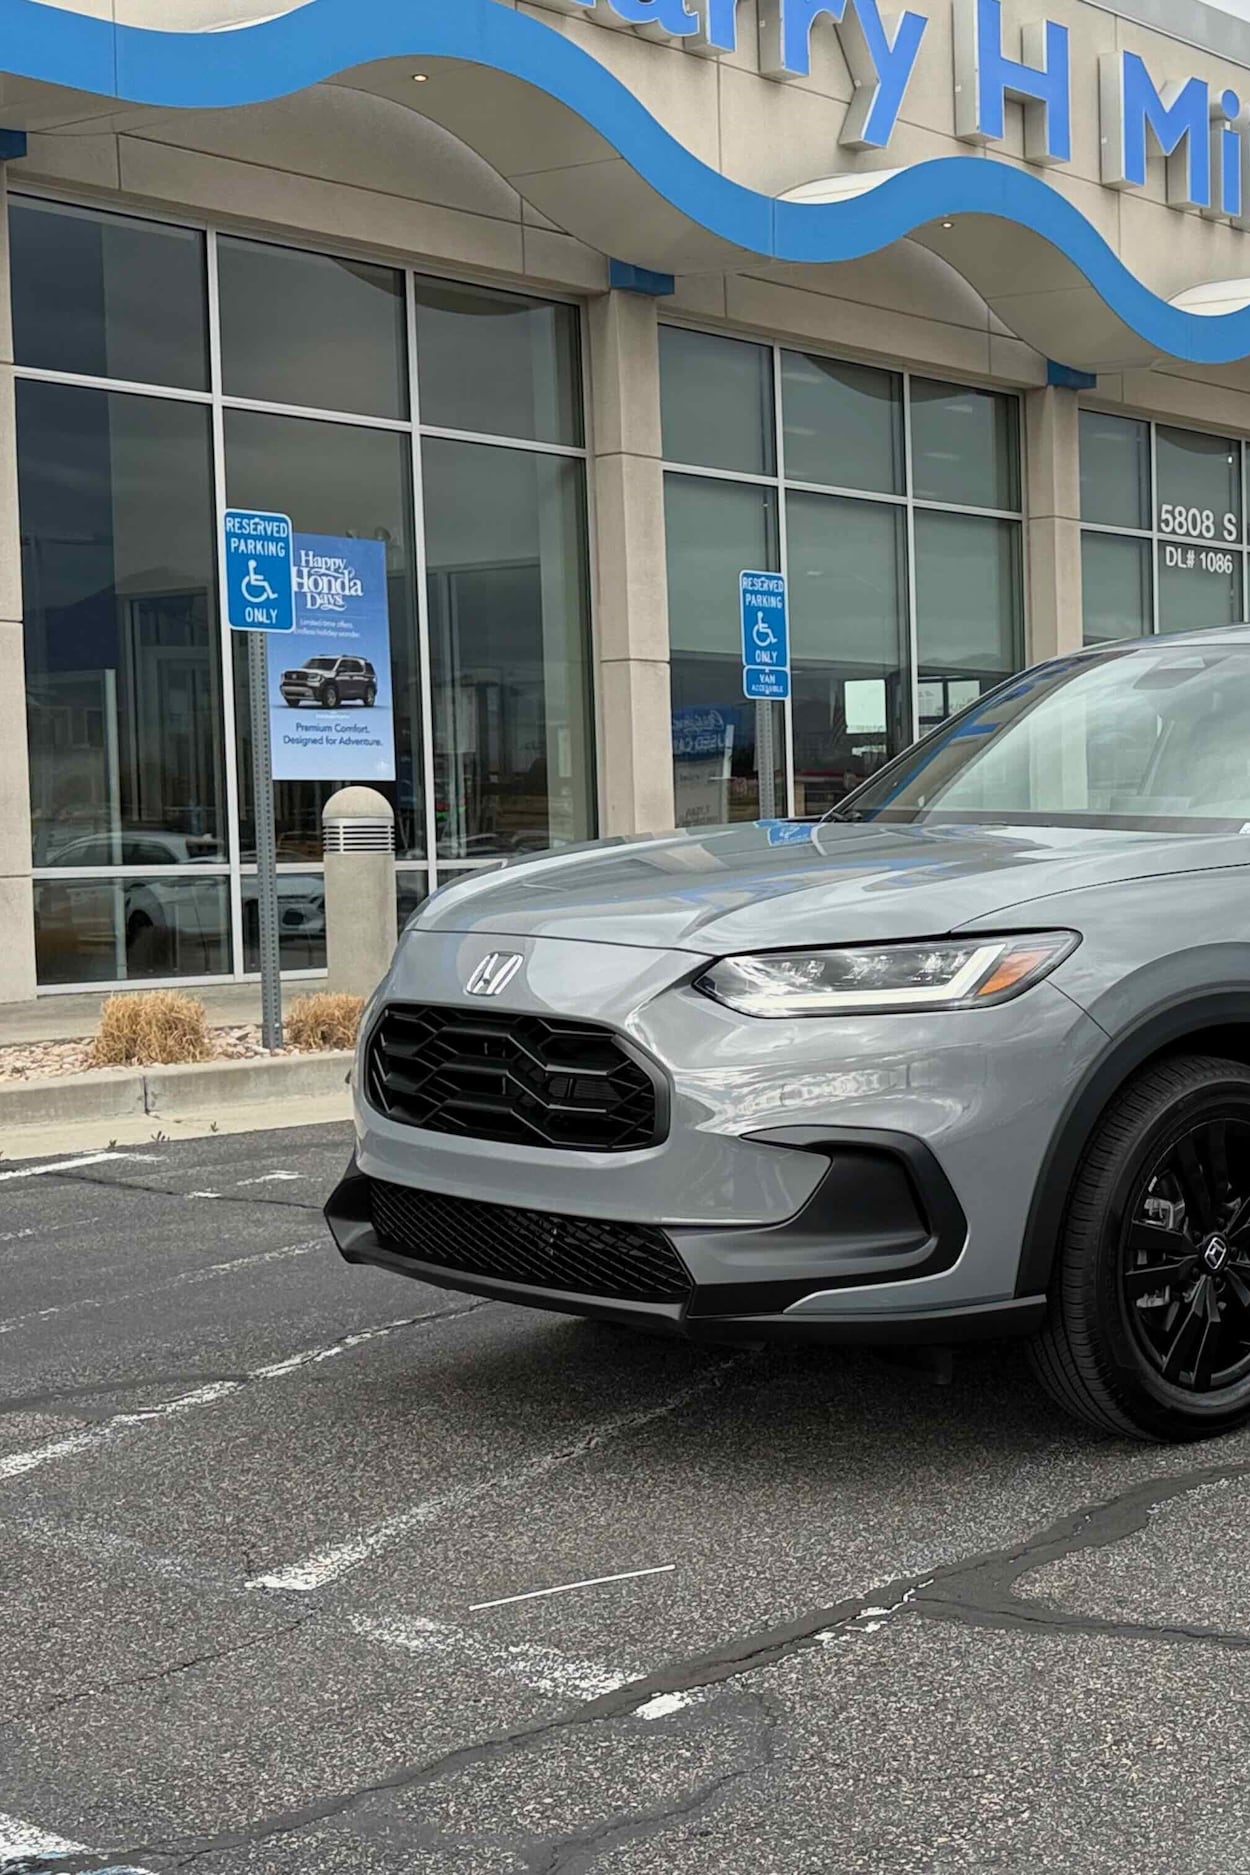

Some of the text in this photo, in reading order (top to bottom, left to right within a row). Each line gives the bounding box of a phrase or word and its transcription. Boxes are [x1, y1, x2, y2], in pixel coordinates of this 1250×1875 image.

[574, 0, 927, 151] rry
[975, 0, 1071, 164] H
[226, 517, 288, 538] RESERVED
[1160, 504, 1237, 541] 5808 S
[230, 538, 286, 557] PARKING
[300, 550, 346, 577] Happy
[1165, 546, 1233, 574] DL# 1086
[293, 566, 364, 596] Honda
[743, 577, 784, 592] RESERVED
[306, 592, 347, 611] Days
[745, 593, 783, 608] PARKING
[245, 607, 278, 624] ONLY
[755, 650, 778, 664] ONLY
[759, 674, 776, 684] VAN
[296, 722, 332, 733] Premium
[283, 735, 324, 747] Designed
[326, 736, 338, 745] for
